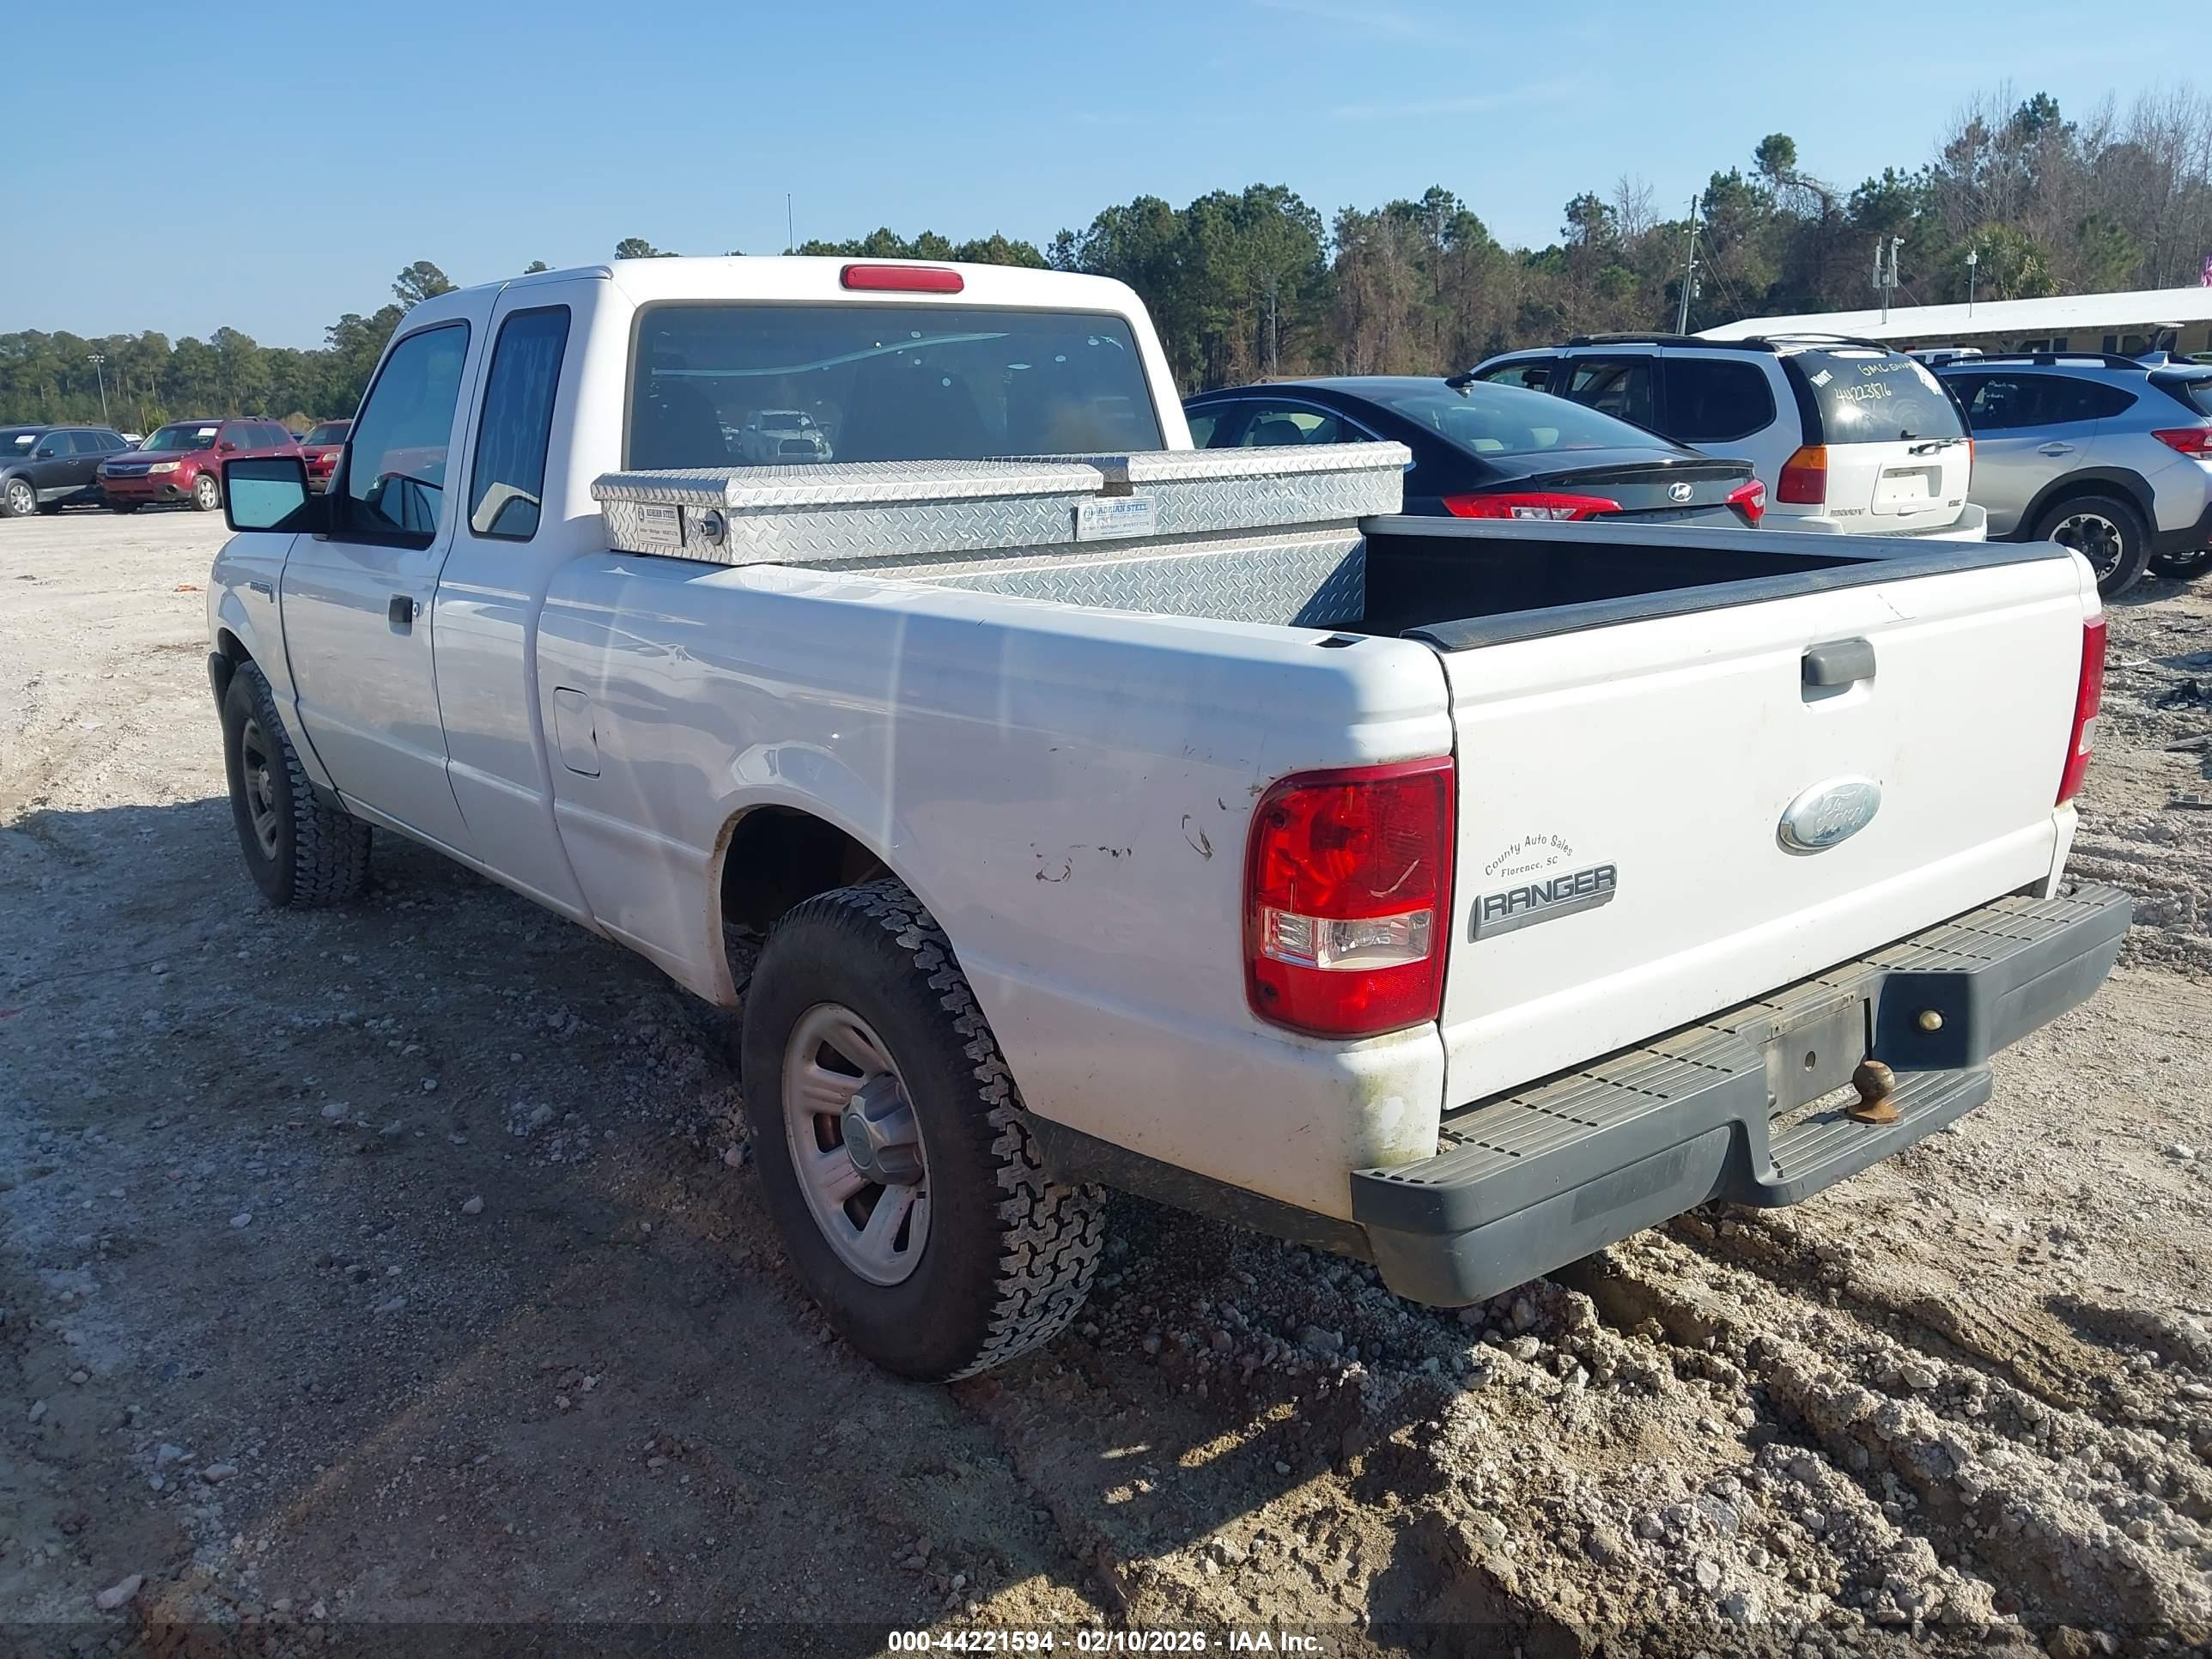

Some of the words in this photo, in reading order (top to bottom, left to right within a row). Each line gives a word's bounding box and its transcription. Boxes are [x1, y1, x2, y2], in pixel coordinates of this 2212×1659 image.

[1857, 363, 1889, 376] GMC
[1834, 382, 1892, 405] 44223876
[1127, 503, 1148, 512] STEEL
[1485, 842, 1521, 876] County
[1524, 833, 1547, 847] Auto
[1550, 834, 1573, 856] Sales
[1501, 861, 1543, 878] Florence,
[1547, 855, 1559, 866] SC
[1483, 864, 1616, 921] RANGER
